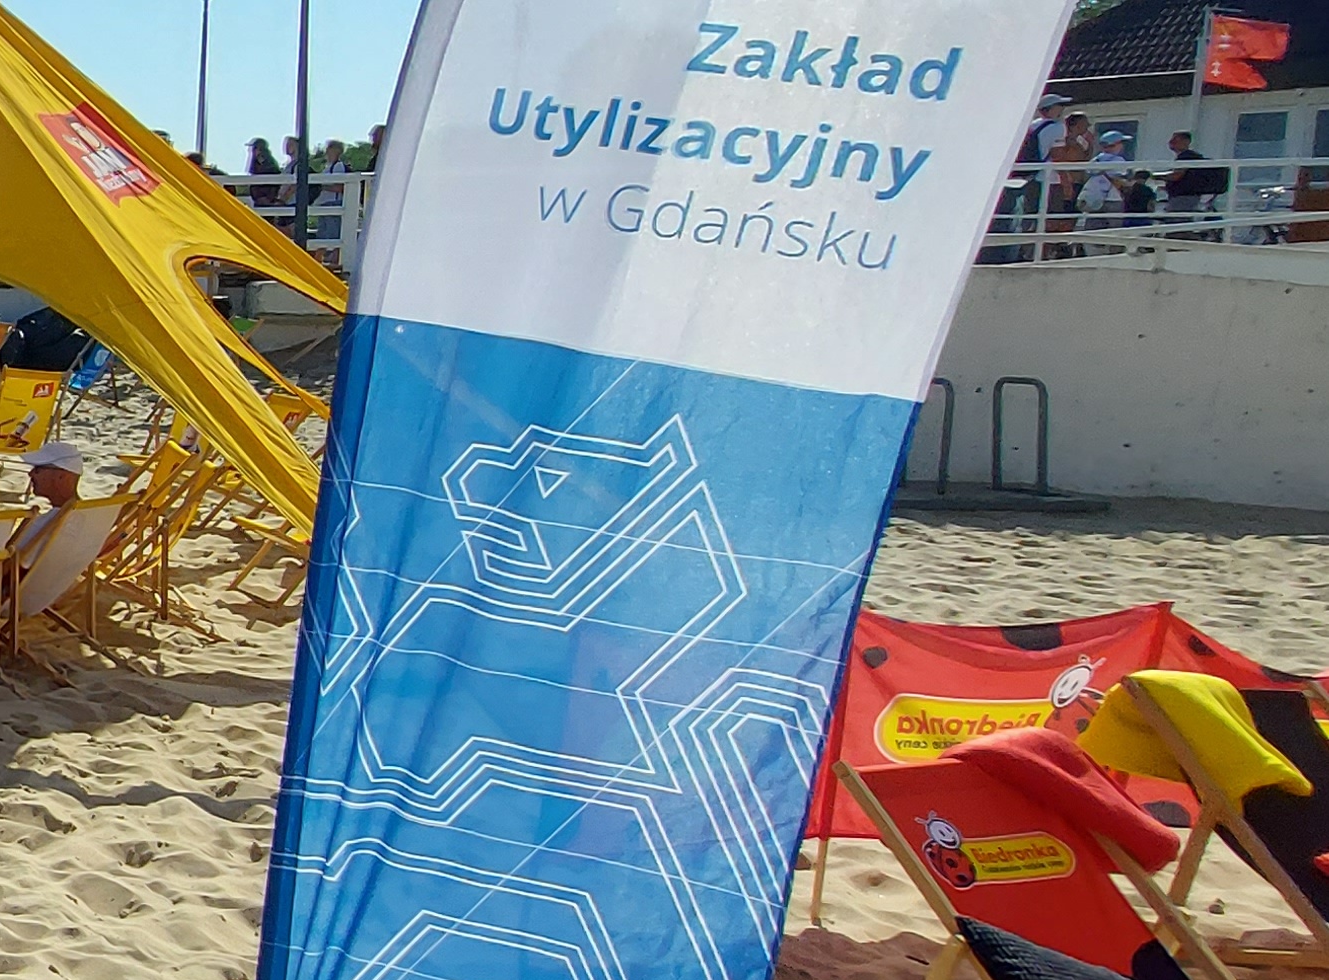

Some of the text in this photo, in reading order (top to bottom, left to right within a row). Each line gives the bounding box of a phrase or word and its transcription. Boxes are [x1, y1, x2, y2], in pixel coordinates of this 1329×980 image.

[686, 21, 964, 101] Zakład
[488, 87, 932, 200] Utylizacyjny
[539, 184, 898, 271] w Gdańsku
[970, 843, 1061, 865] Biedronka
